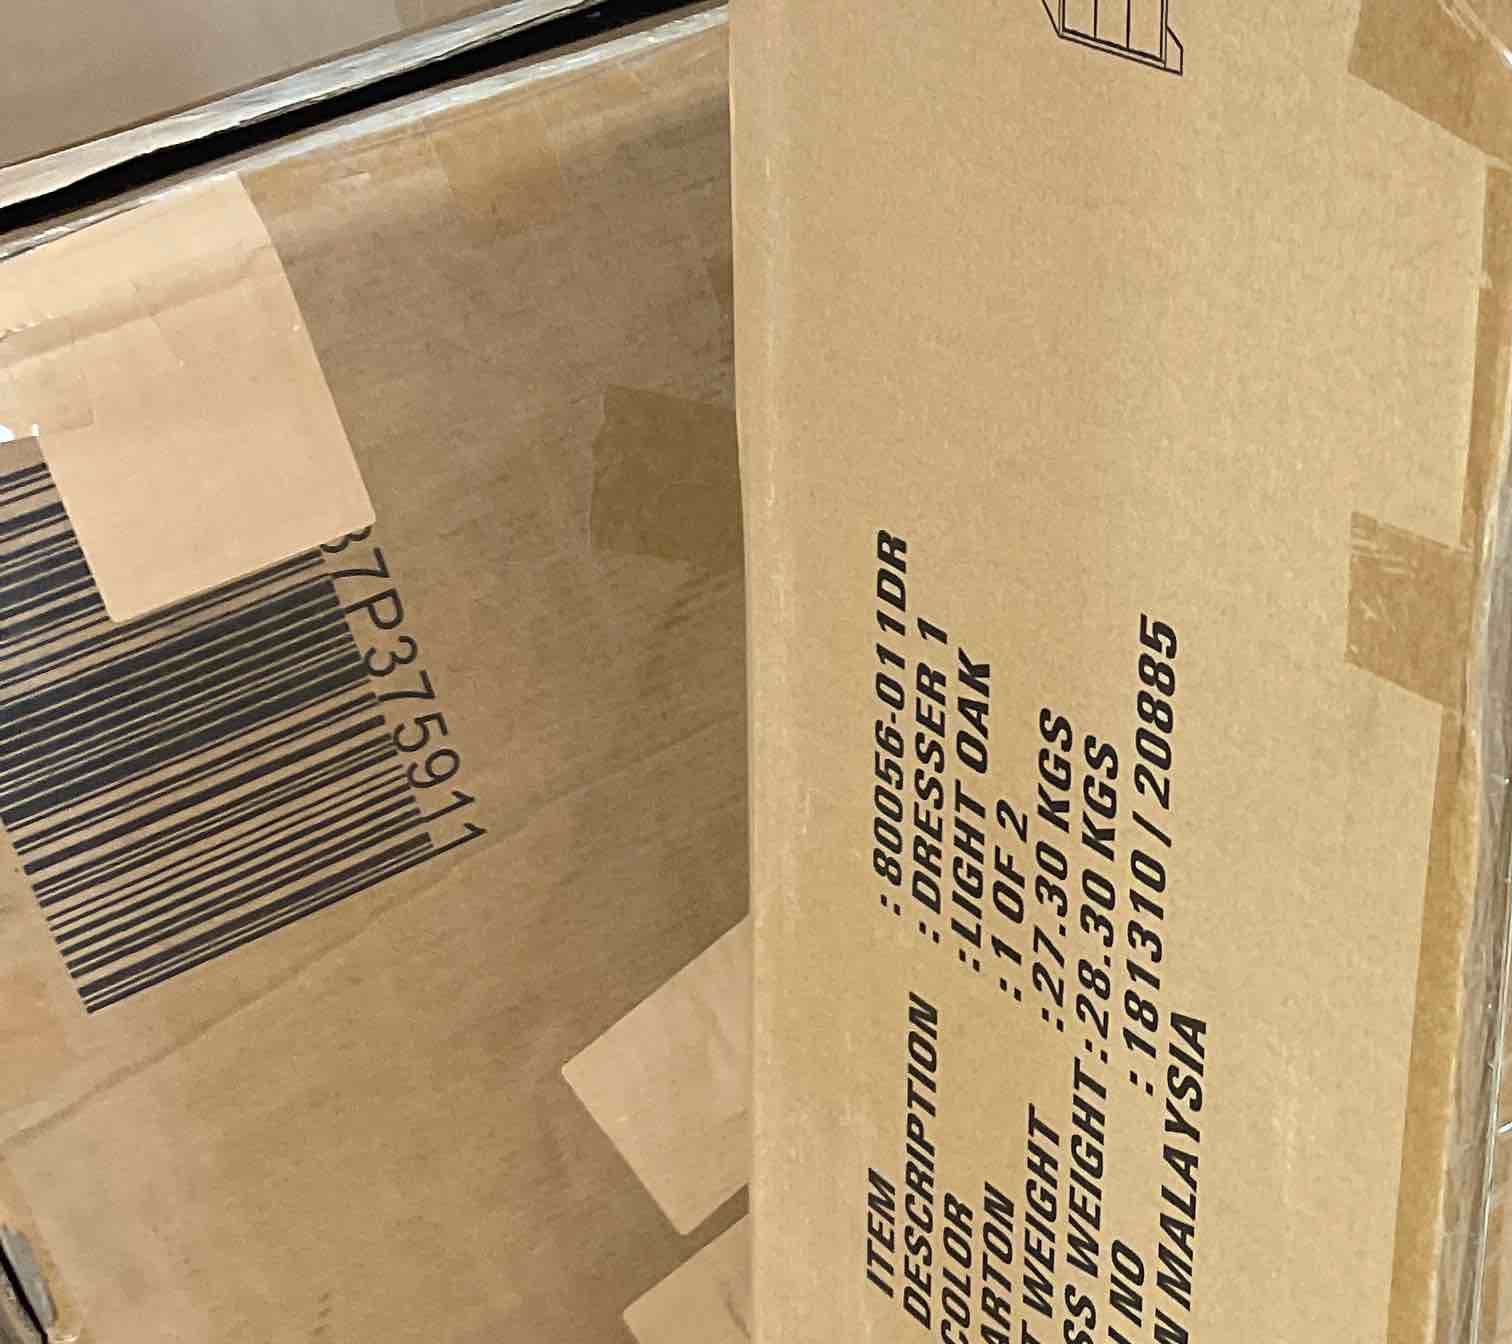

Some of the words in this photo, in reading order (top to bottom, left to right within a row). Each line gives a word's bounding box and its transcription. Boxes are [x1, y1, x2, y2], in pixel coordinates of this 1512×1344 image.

[917, 617, 947, 645] 1
[873, 530, 907, 886] 80056-011DR
[957, 648, 990, 774] OAK
[1037, 708, 1072, 833] KGS
[1134, 613, 1177, 810] 20885
[912, 663, 946, 915] DRESSER
[996, 800, 1027, 843] 2
[1082, 735, 1118, 862] KGS
[993, 845, 1025, 924] OF
[991, 935, 1021, 965] 1
[1123, 849, 1166, 1059] 181310
[903, 992, 937, 1330] DESCRIPTION
[1023, 1103, 1059, 1319] WEIGHT
[1157, 1012, 1206, 1312] MALAYSIA
[867, 1168, 895, 1298] ITEM
[1110, 1240, 1144, 1328] NO
